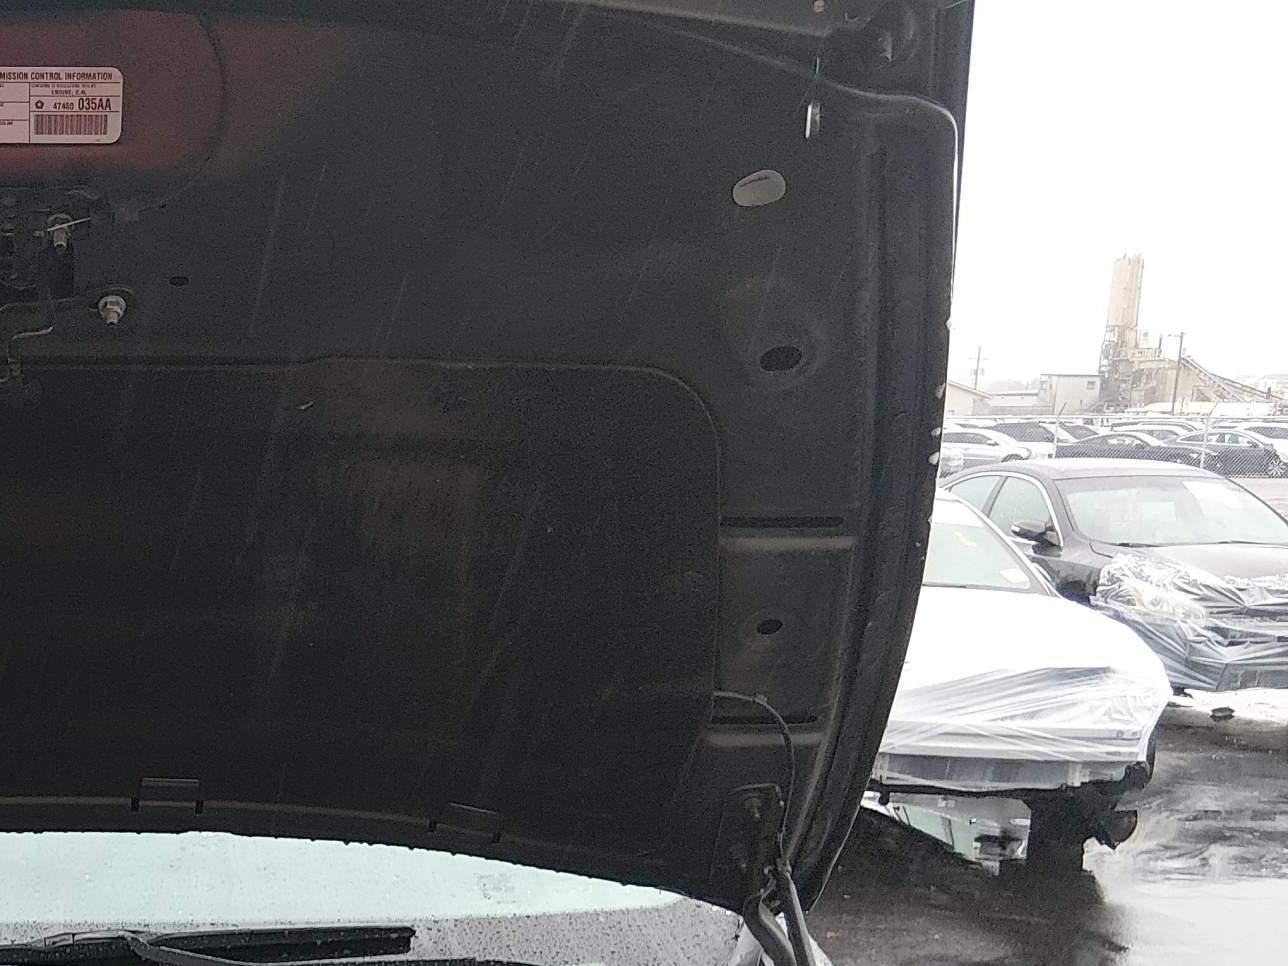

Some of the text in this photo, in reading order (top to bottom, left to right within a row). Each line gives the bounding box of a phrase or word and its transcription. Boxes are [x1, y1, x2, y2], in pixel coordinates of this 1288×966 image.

[30, 71, 63, 81] CONTROL
[64, 72, 113, 81] INFORMATION
[78, 97, 112, 111] 035AA
